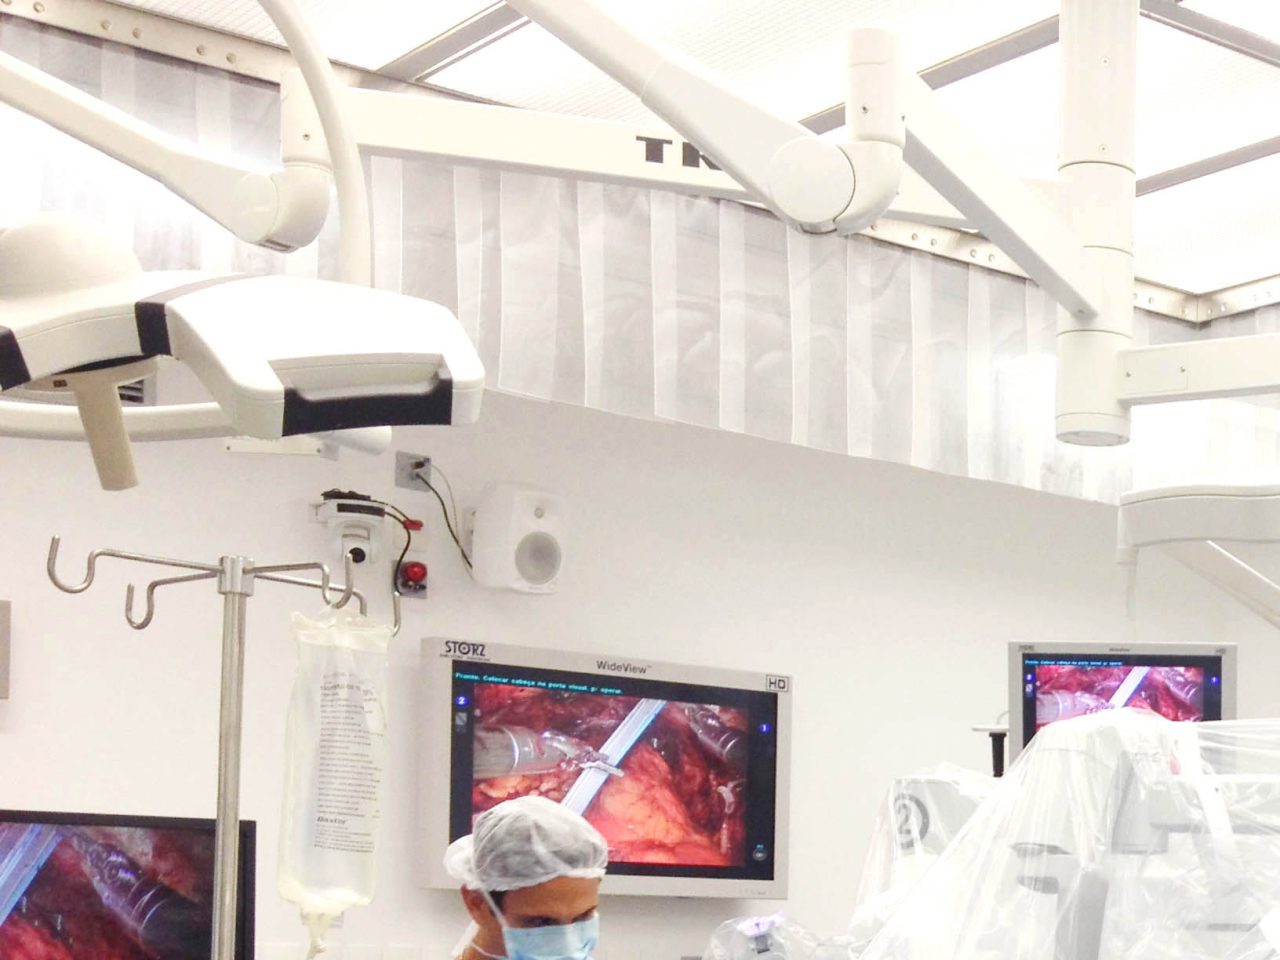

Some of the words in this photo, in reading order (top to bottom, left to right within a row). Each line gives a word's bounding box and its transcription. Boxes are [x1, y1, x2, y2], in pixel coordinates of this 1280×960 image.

[445, 641, 486, 656] STORZ
[596, 661, 648, 674] WideView
[768, 677, 786, 689] HD
